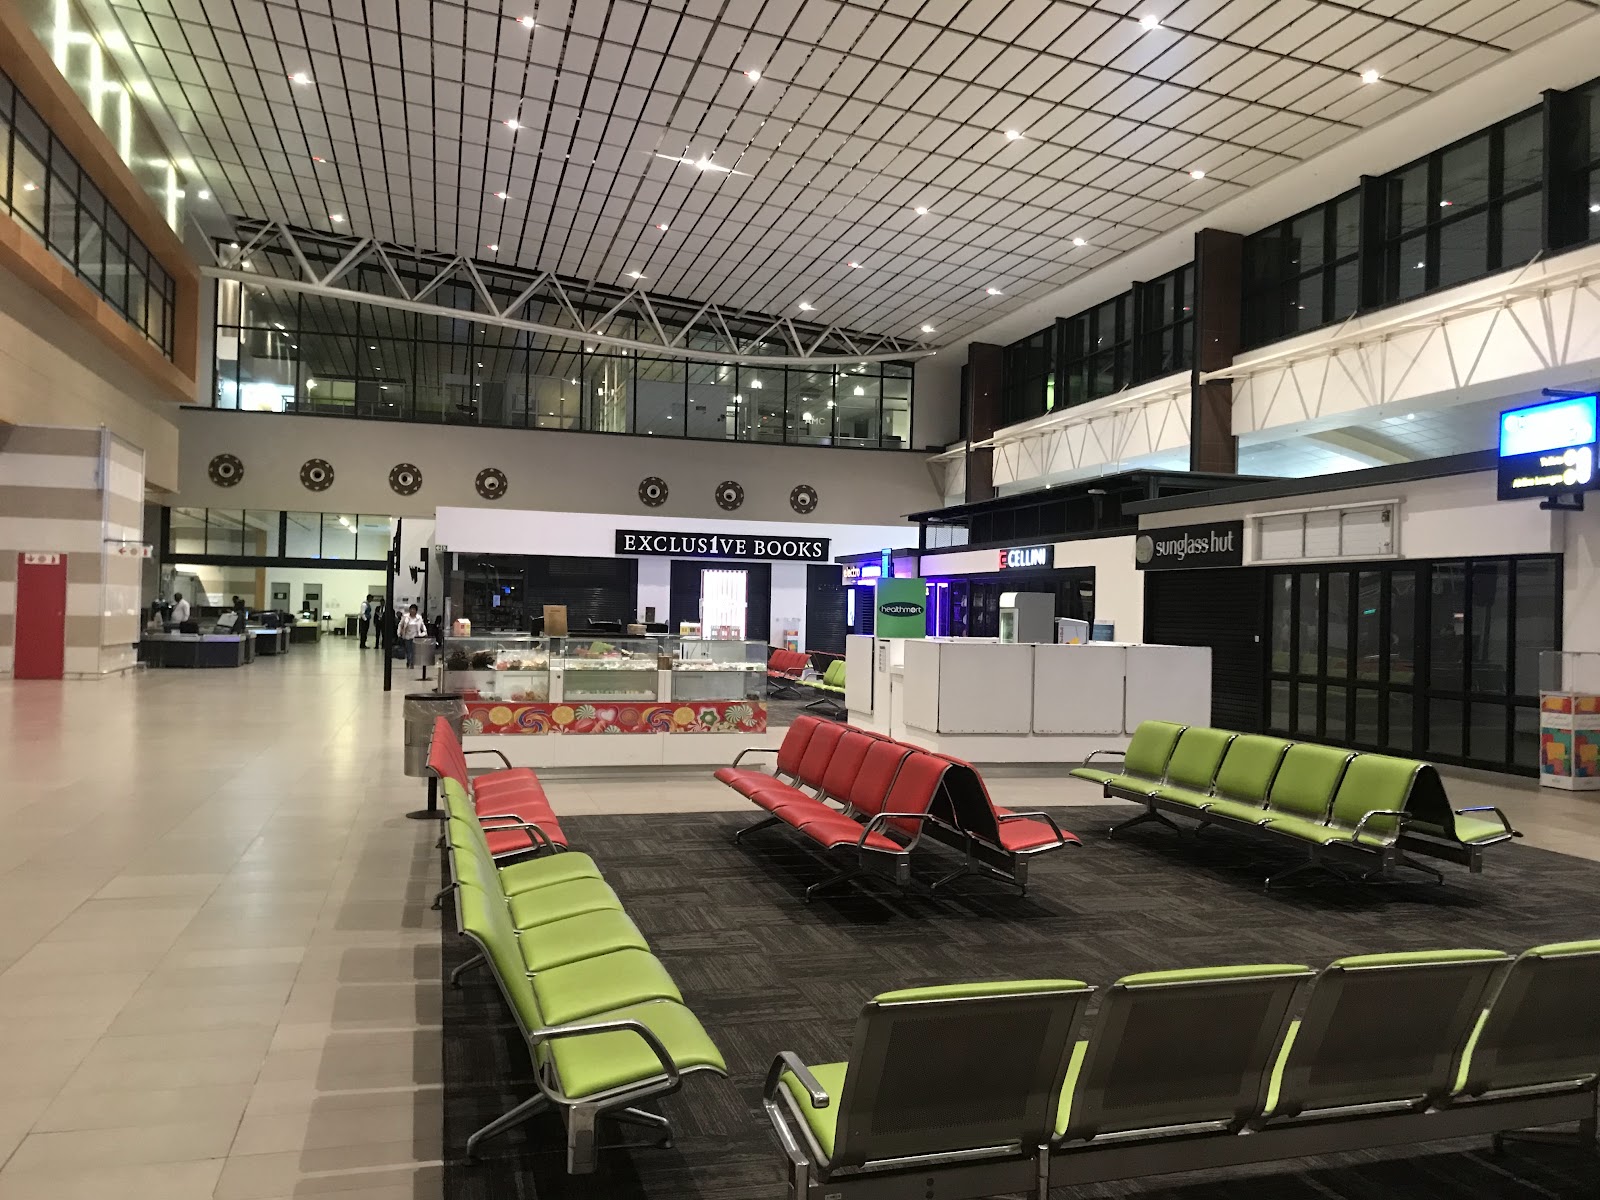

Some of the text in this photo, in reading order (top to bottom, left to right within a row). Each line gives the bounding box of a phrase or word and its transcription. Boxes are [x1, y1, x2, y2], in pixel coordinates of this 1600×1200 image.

[753, 540, 823, 558] BOOKS
[1155, 530, 1235, 561] sunglass hut
[1007, 548, 1047, 568] CELLINI
